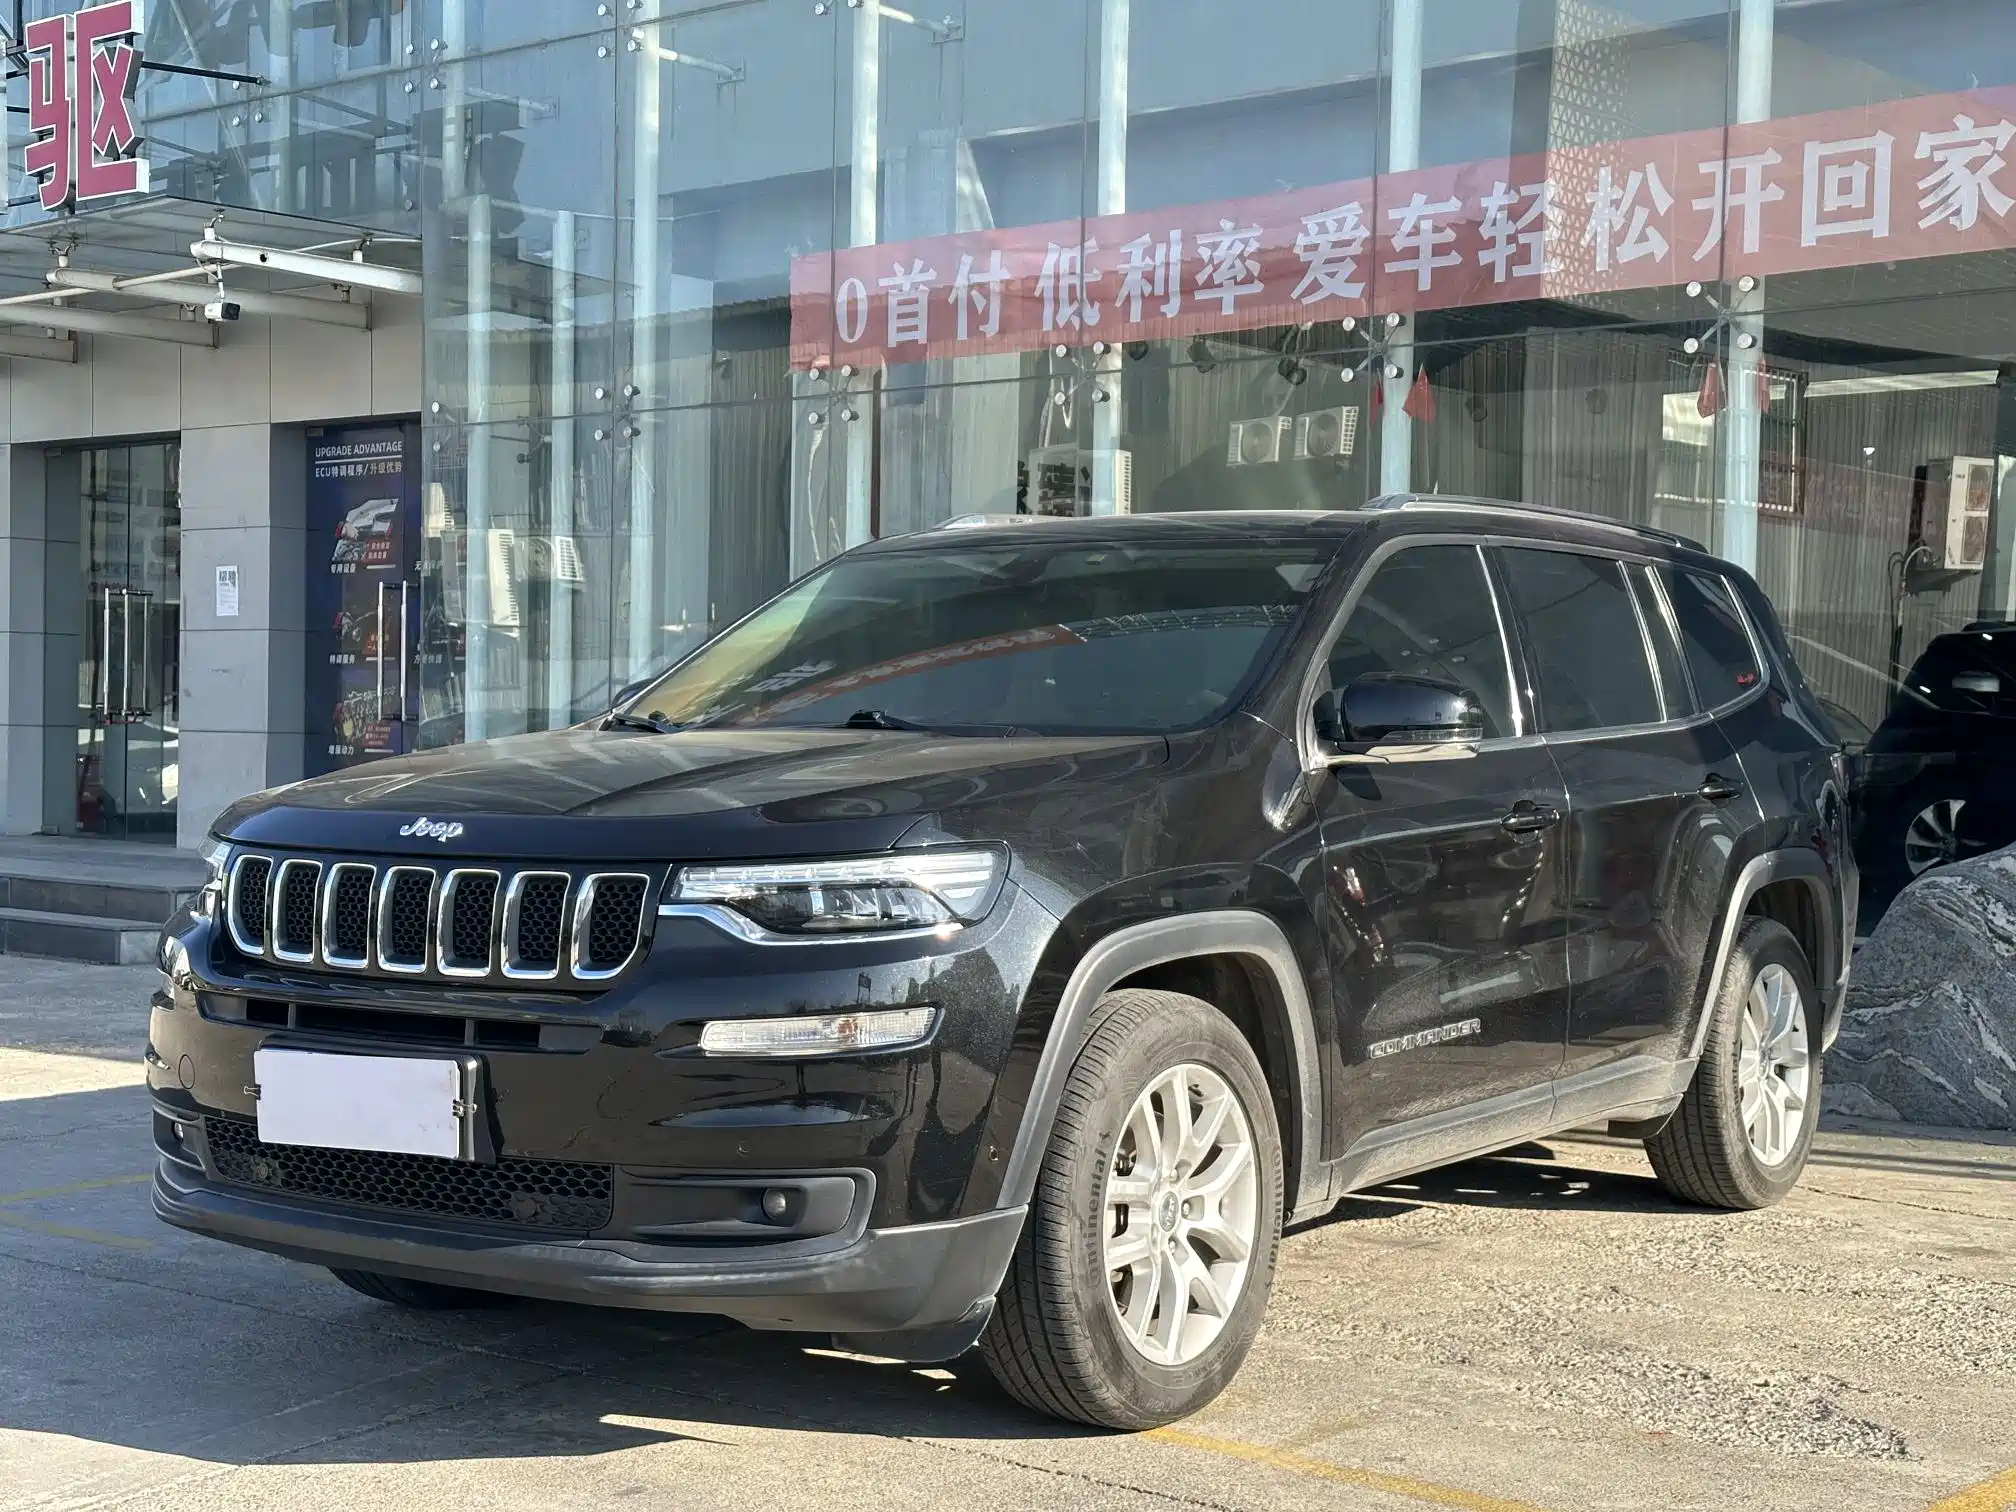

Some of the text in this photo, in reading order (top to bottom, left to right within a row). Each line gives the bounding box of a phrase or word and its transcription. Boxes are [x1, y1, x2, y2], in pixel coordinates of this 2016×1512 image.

[24, 0, 145, 211] 驱
[315, 441, 402, 458] UPGRADE ADVANTAGE
[399, 816, 464, 843] Jeep
[1367, 1018, 1481, 1059] COMMANDER
